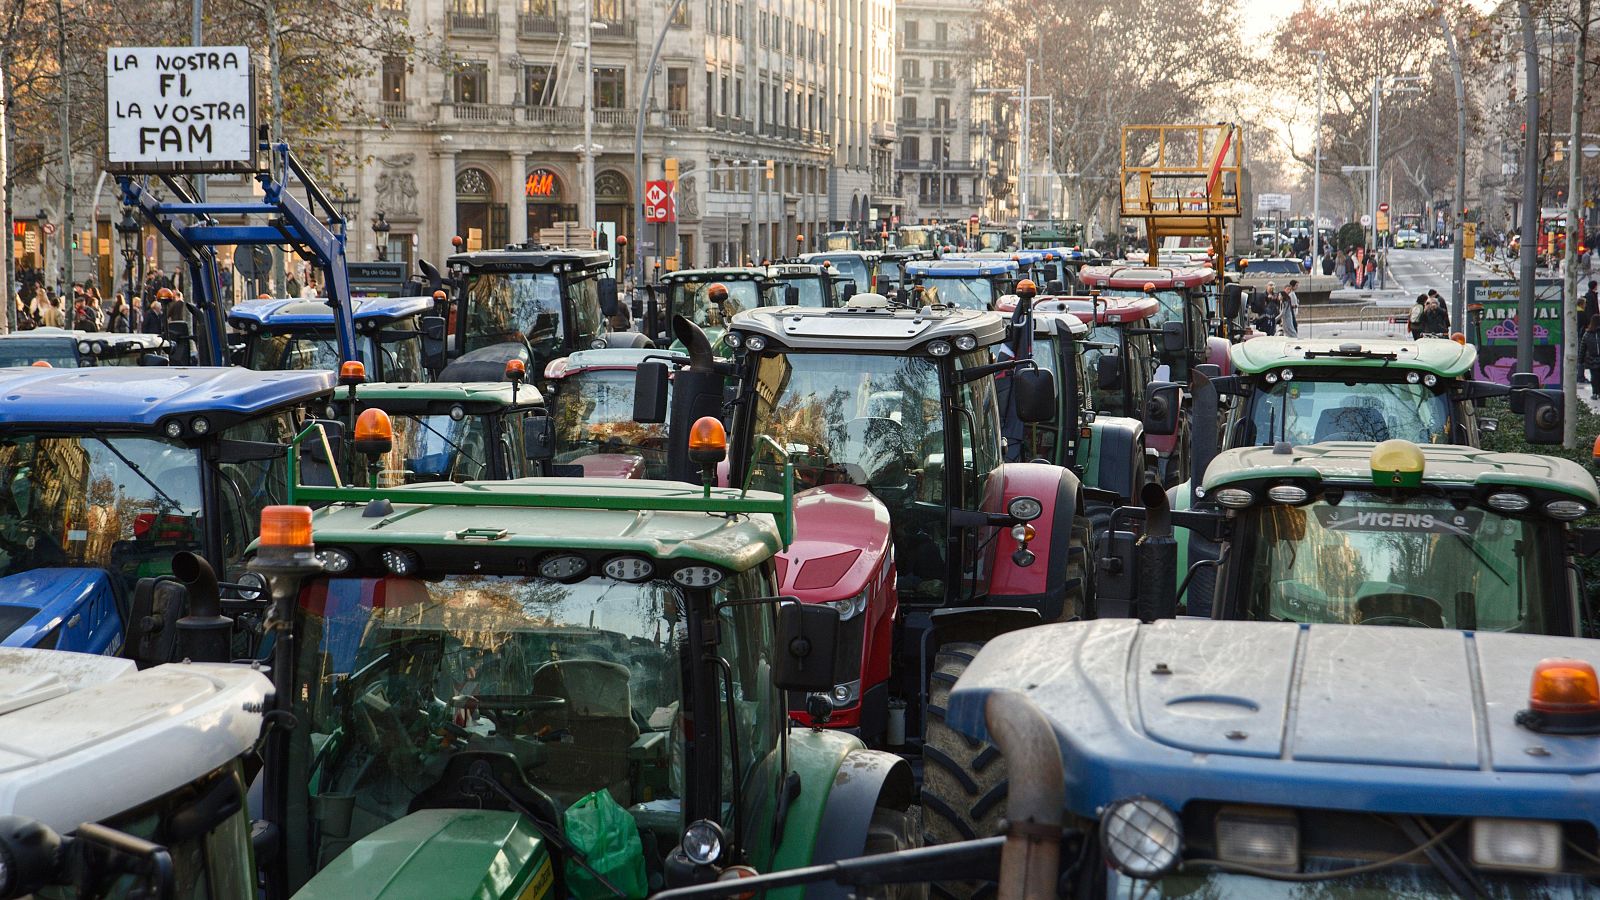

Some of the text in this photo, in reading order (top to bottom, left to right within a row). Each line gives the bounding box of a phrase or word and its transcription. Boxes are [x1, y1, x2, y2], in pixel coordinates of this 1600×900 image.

[114, 52, 238, 71] LA NOSTRA
[160, 73, 192, 97] FI,
[116, 101, 245, 122] LA VOSTRA
[140, 123, 212, 154] FAM
[651, 190, 660, 200] M
[1357, 511, 1434, 528] VICENS
